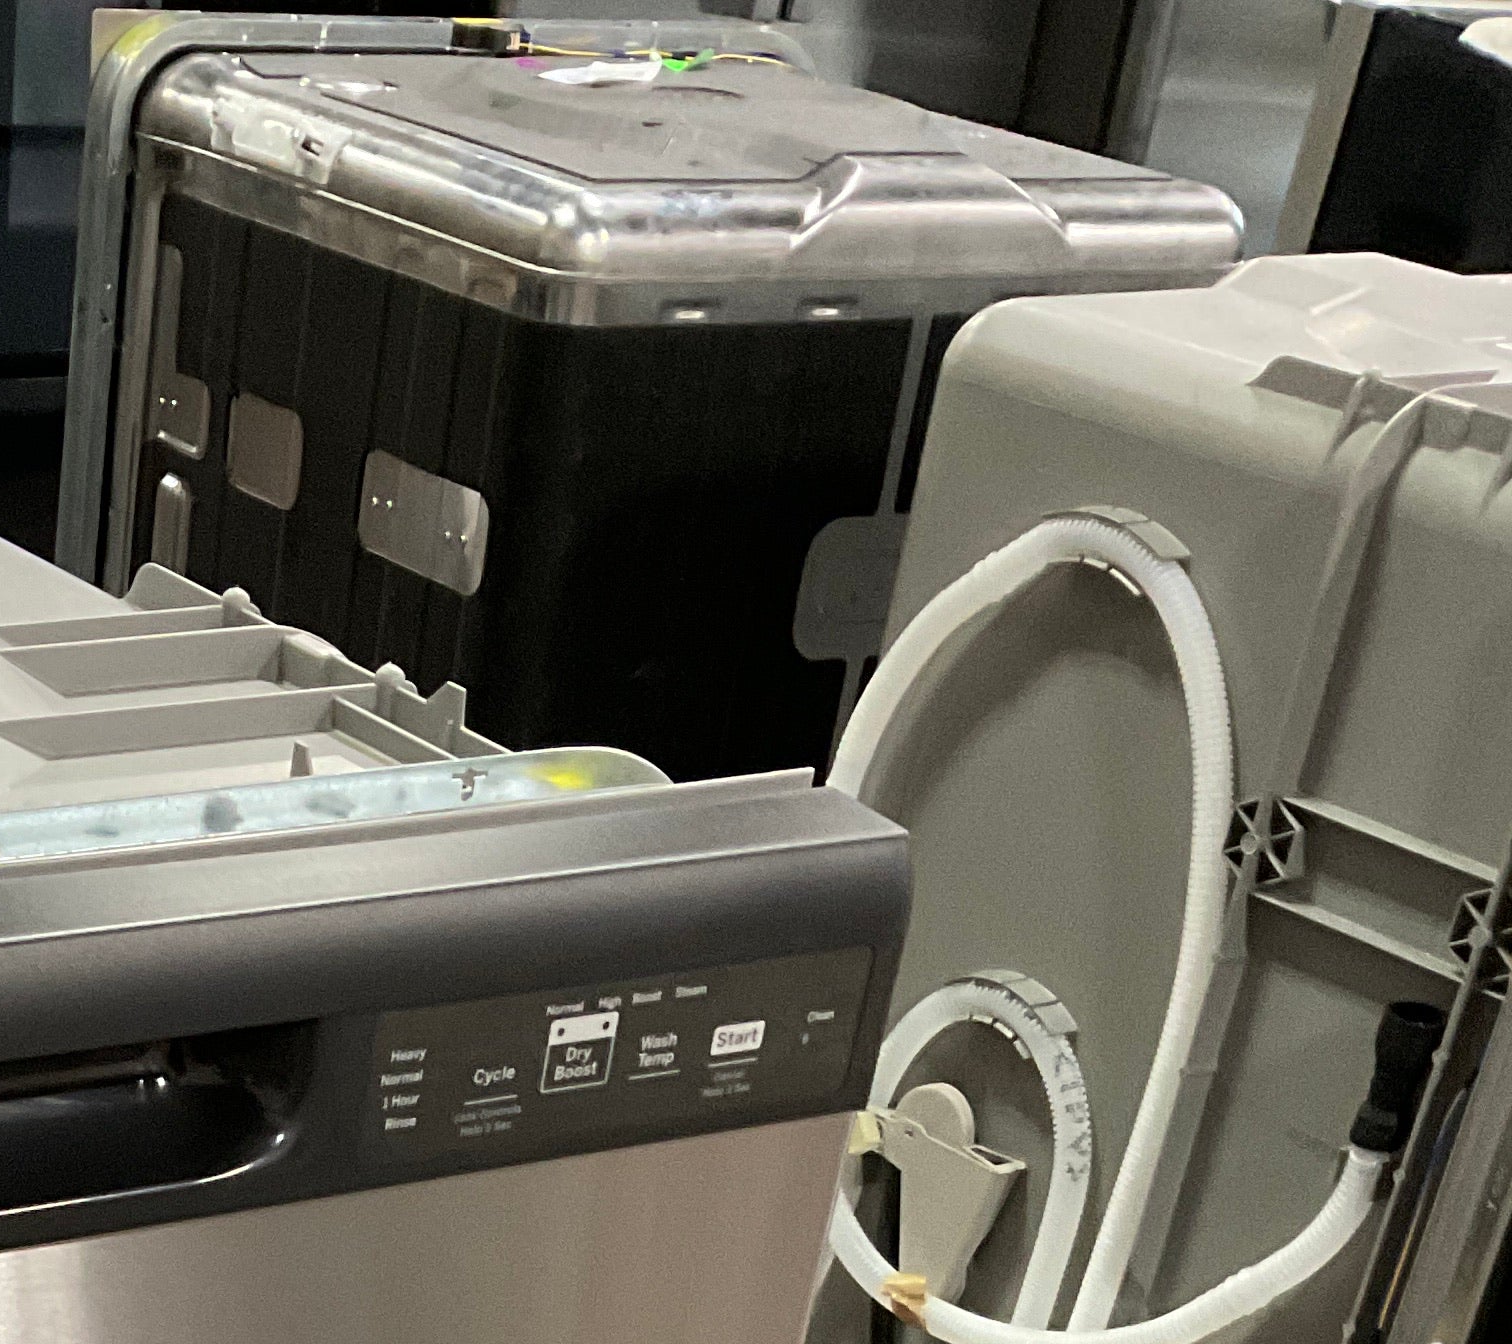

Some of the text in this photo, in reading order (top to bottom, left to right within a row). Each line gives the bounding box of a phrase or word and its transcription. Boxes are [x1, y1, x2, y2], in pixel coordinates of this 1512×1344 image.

[641, 1032, 678, 1051] Wash
[717, 1028, 758, 1047] Start
[391, 1049, 427, 1063] Heavy
[565, 1047, 592, 1063] Dry
[639, 1052, 675, 1068] Temp
[380, 1069, 424, 1086] Normal
[473, 1066, 516, 1086] Cycle
[554, 1062, 597, 1081] Boost
[392, 1095, 421, 1107] Hour
